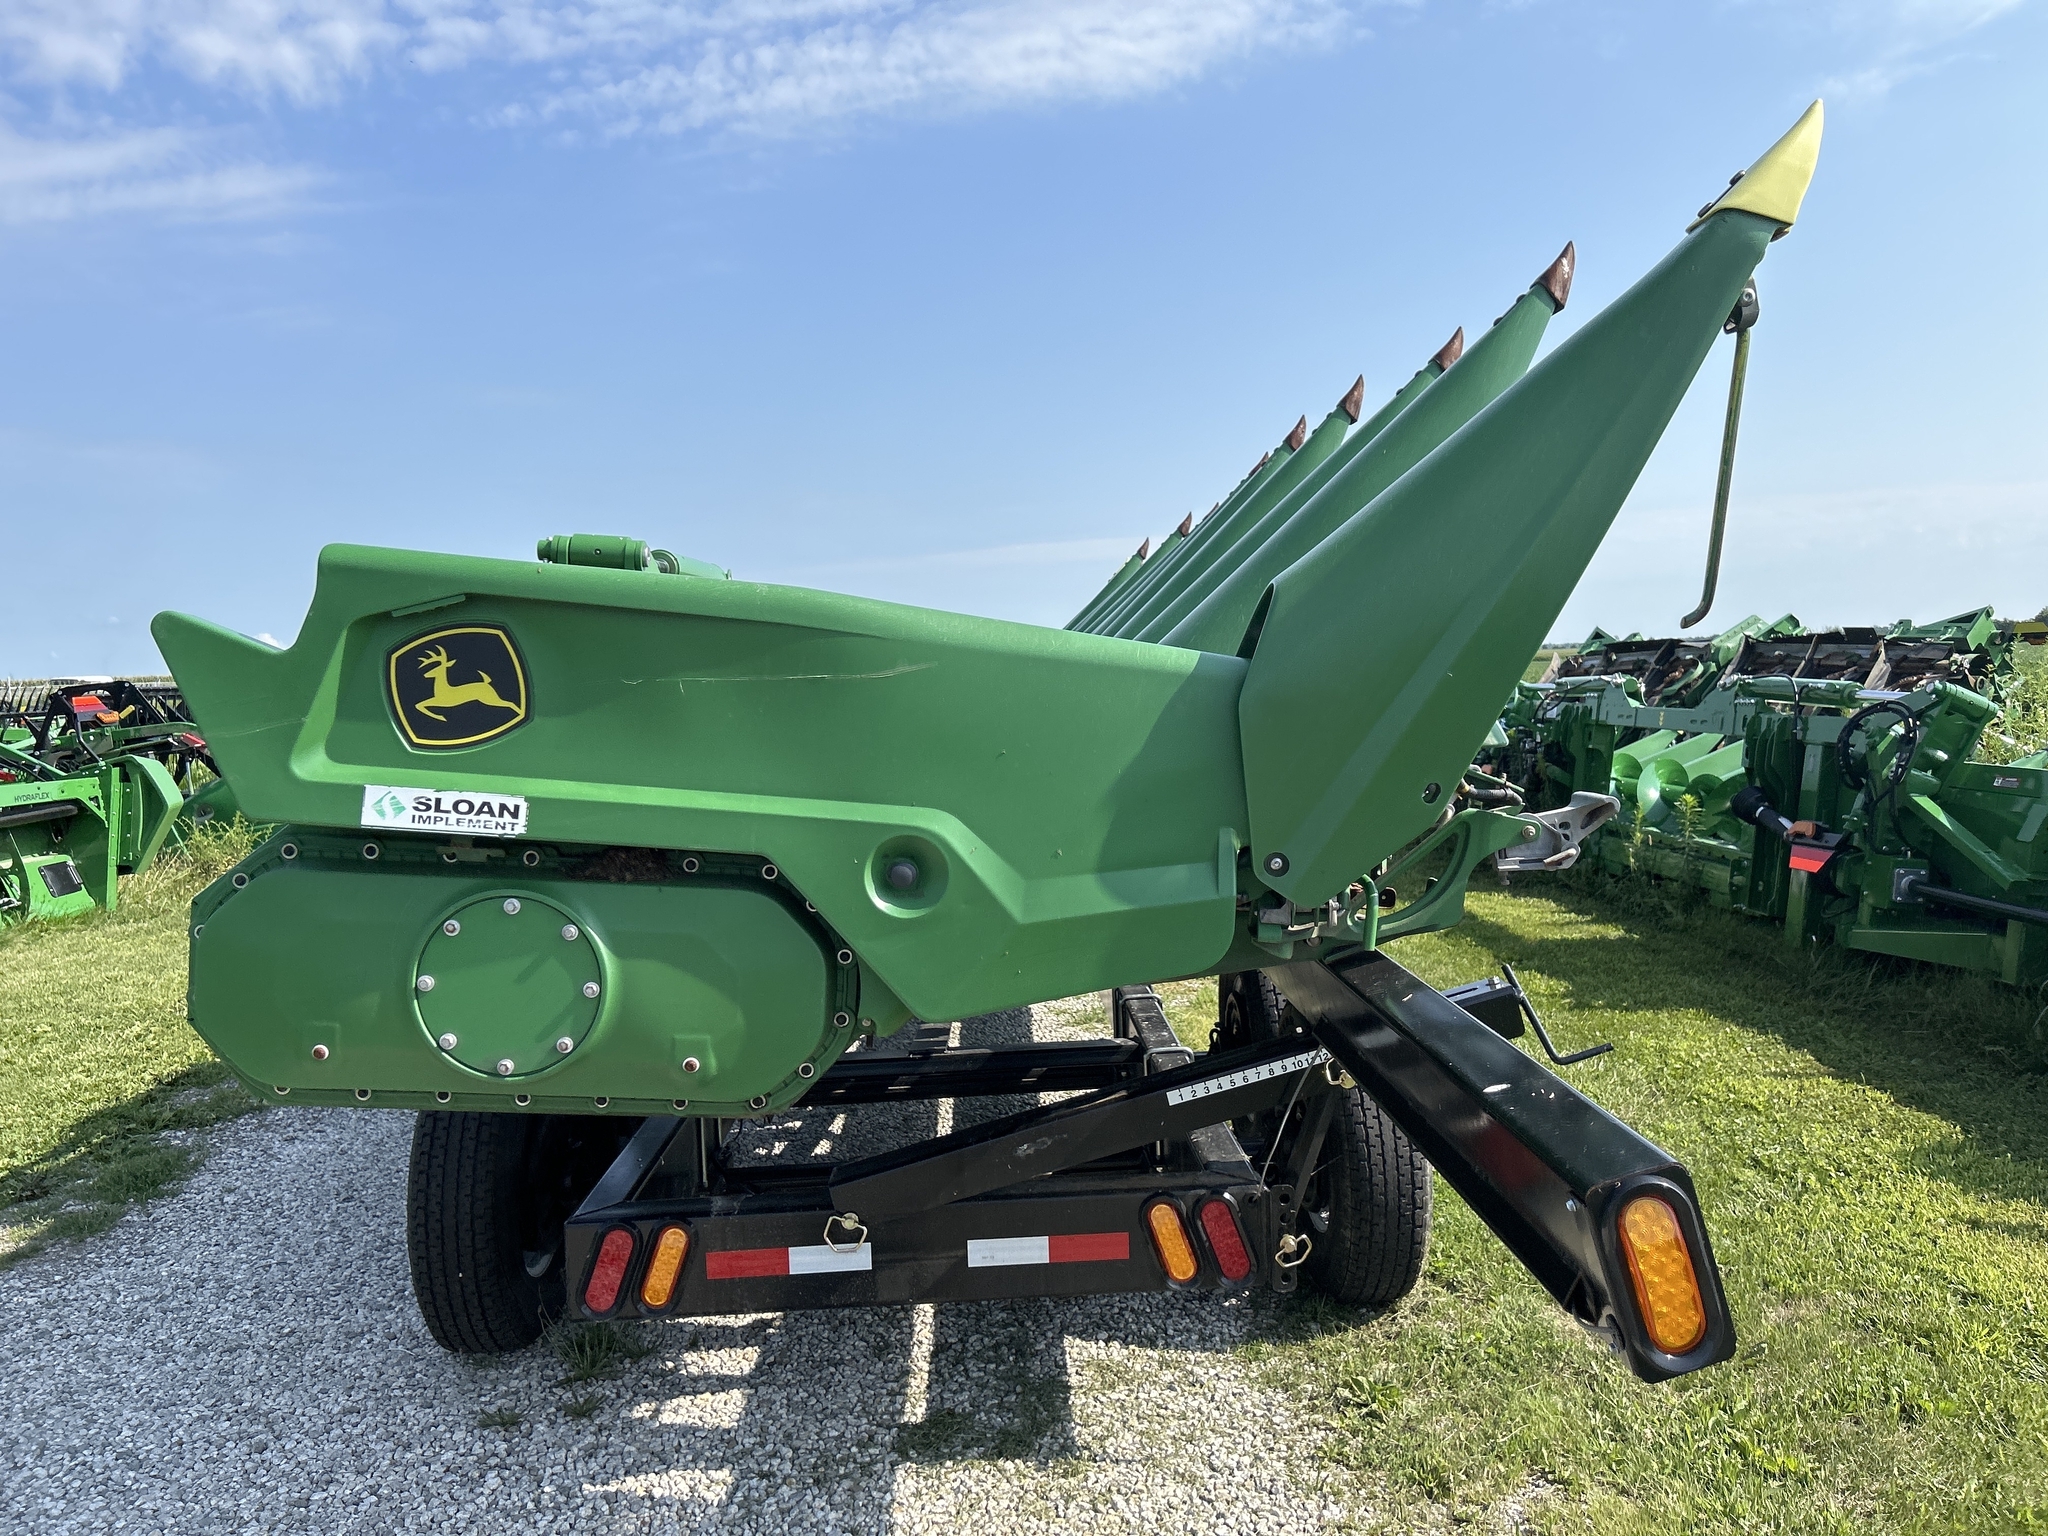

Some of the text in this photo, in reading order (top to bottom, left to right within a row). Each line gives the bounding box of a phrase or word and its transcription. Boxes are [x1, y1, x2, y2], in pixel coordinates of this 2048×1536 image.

[14, 792, 50, 803] HYDRAFLEX
[412, 796, 520, 819] SLOAN
[411, 814, 519, 832] IMPLEMENT
[1178, 1093, 1184, 1101] 1
[1190, 1089, 1198, 1098] 2
[1203, 1086, 1211, 1095] 3
[1216, 1082, 1223, 1091] 4
[1229, 1078, 1237, 1087] 5
[1242, 1075, 1250, 1084] 6
[1255, 1071, 1262, 1080] 7
[1268, 1067, 1275, 1077] 8
[1281, 1064, 1288, 1073] 9
[1292, 1059, 1304, 1070] 10
[1317, 1052, 1330, 1063] 12
